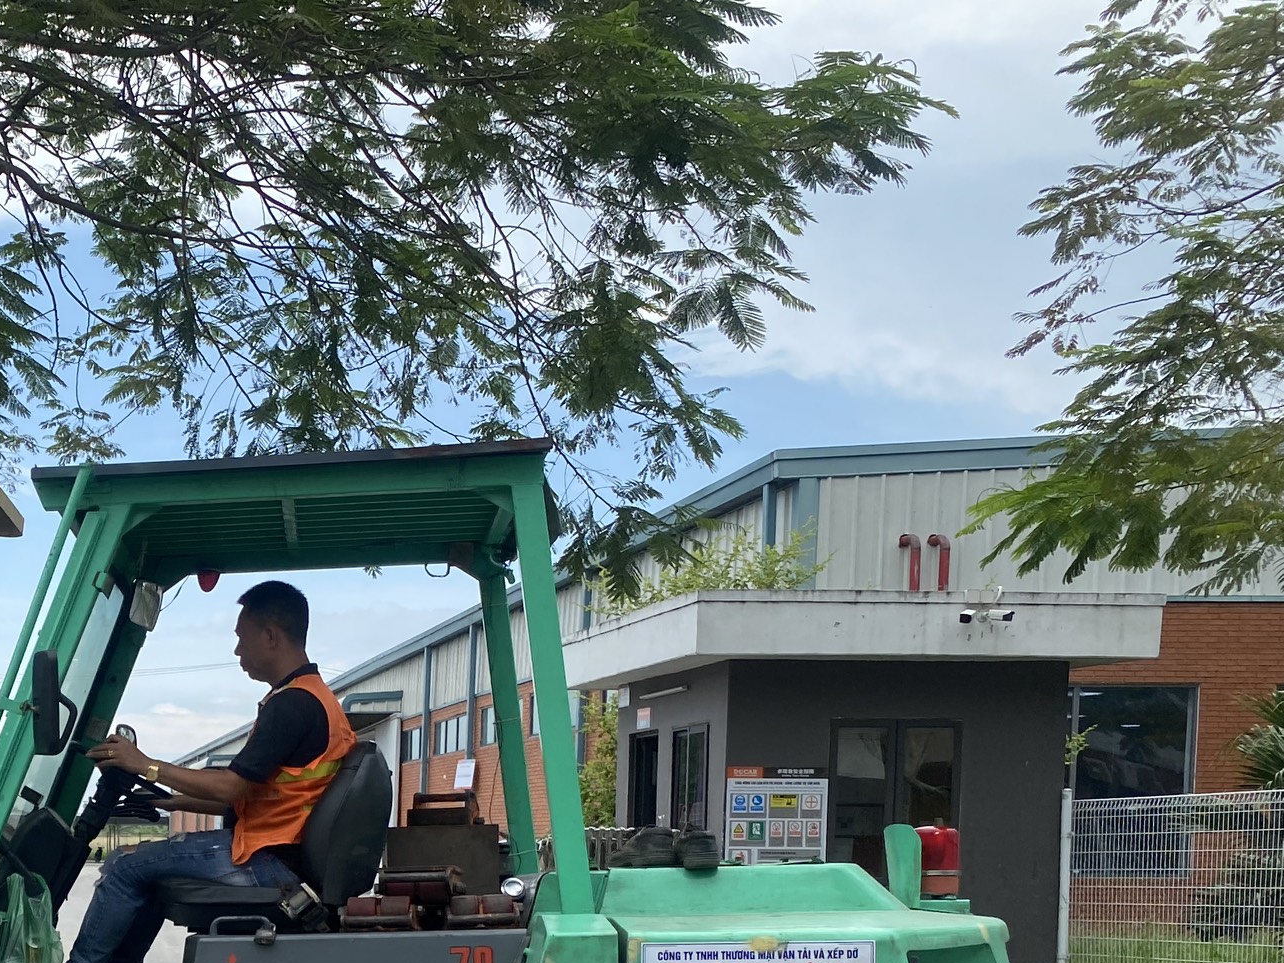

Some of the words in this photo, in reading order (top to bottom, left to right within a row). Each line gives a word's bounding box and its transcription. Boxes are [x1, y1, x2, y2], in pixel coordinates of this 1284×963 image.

[657, 950, 681, 960] CÔNG
[683, 951, 694, 960] TY
[696, 951, 718, 960] TNHH
[721, 950, 755, 960] THƯƠNG
[757, 950, 775, 962] MẠI
[797, 946, 811, 959] TẢI
[813, 947, 825, 959] VÀ
[827, 947, 844, 959] XẾP
